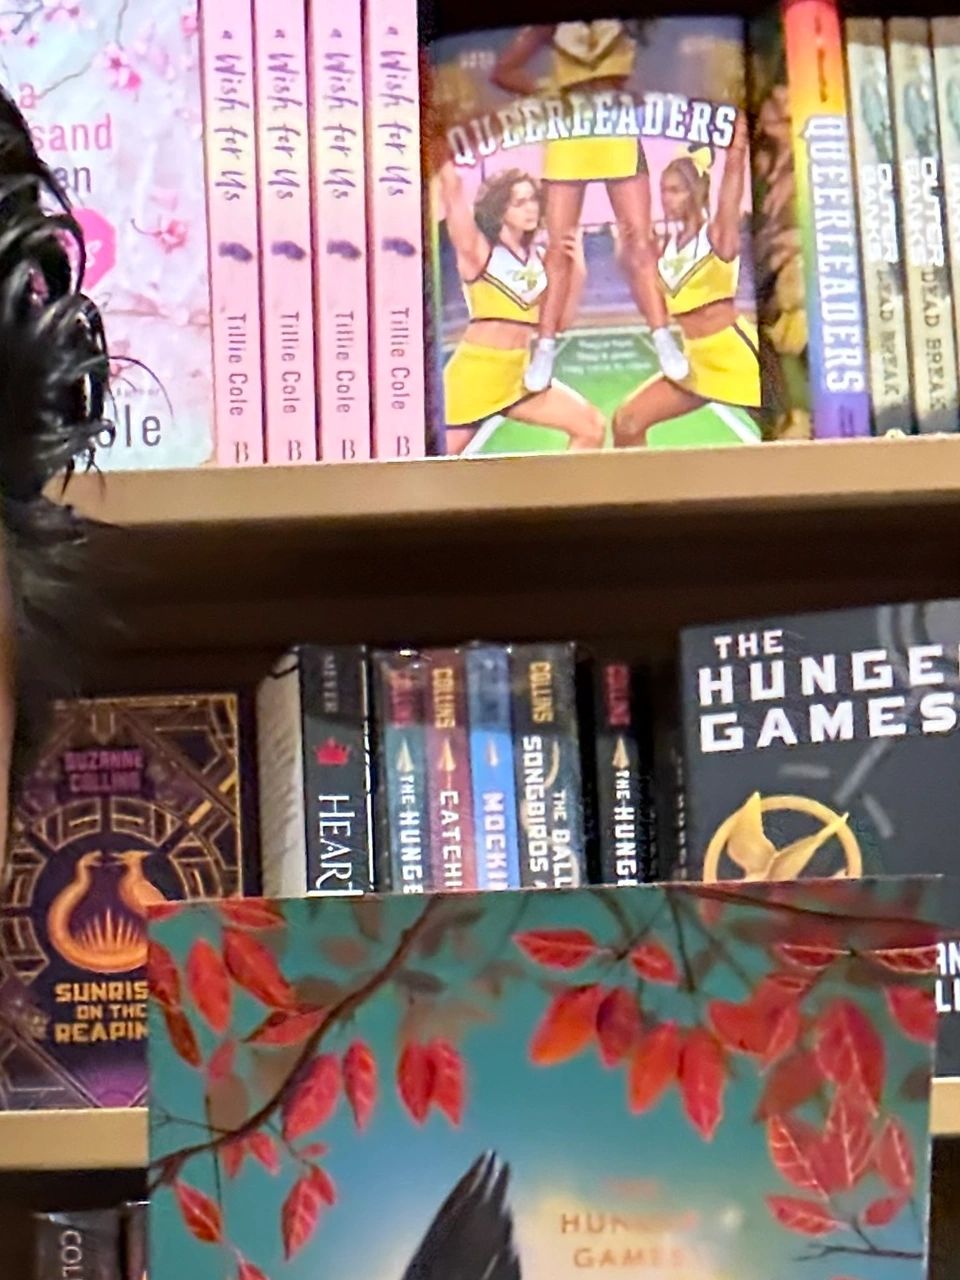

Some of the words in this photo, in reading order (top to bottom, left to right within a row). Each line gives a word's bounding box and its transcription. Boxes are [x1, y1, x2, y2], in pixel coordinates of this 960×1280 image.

[19, 83, 36, 109] a
[214, 54, 250, 112] Wish
[267, 53, 303, 111] Wish
[323, 53, 359, 110] Wish
[379, 50, 415, 108] Wish
[30, 113, 113, 151] sand
[213, 126, 248, 161] for
[266, 124, 301, 159] for
[322, 123, 357, 158] for
[377, 121, 412, 155] for
[447, 91, 737, 166] QUEERLEADERS
[878, 164, 898, 263] OUTER
[904, 159, 926, 266] BANKS
[922, 158, 944, 266] OUTER
[803, 117, 865, 393] QUEERLEADERS
[227, 313, 247, 364] Tillie
[281, 312, 300, 362] Tillie
[335, 310, 354, 361] Tillie
[390, 307, 410, 357] Tillie
[228, 373, 248, 416] Cole
[281, 371, 301, 414] Cole
[335, 370, 356, 413] Cole
[391, 367, 411, 410] Cole
[96, 404, 161, 447] ole
[714, 630, 783, 659] THE
[432, 668, 456, 728] COLLINS
[529, 661, 554, 724] COLLINS
[699, 644, 960, 706] HUNGE
[700, 692, 958, 753] GAMES
[399, 776, 415, 804] THE
[523, 736, 548, 873] SONGBIRDS
[553, 789, 568, 821] THE
[615, 770, 630, 800] THE
[311, 795, 361, 895] HEART
[399, 812, 424, 894] HUNGE
[440, 791, 463, 887] CATCHI
[483, 792, 509, 890] MOCKI
[551, 828, 573, 888] BALL
[613, 806, 638, 887] HUNG
[55, 981, 148, 1002] SUNRIS
[76, 1005, 103, 1019] ON
[54, 1021, 148, 1043] REAPIN
